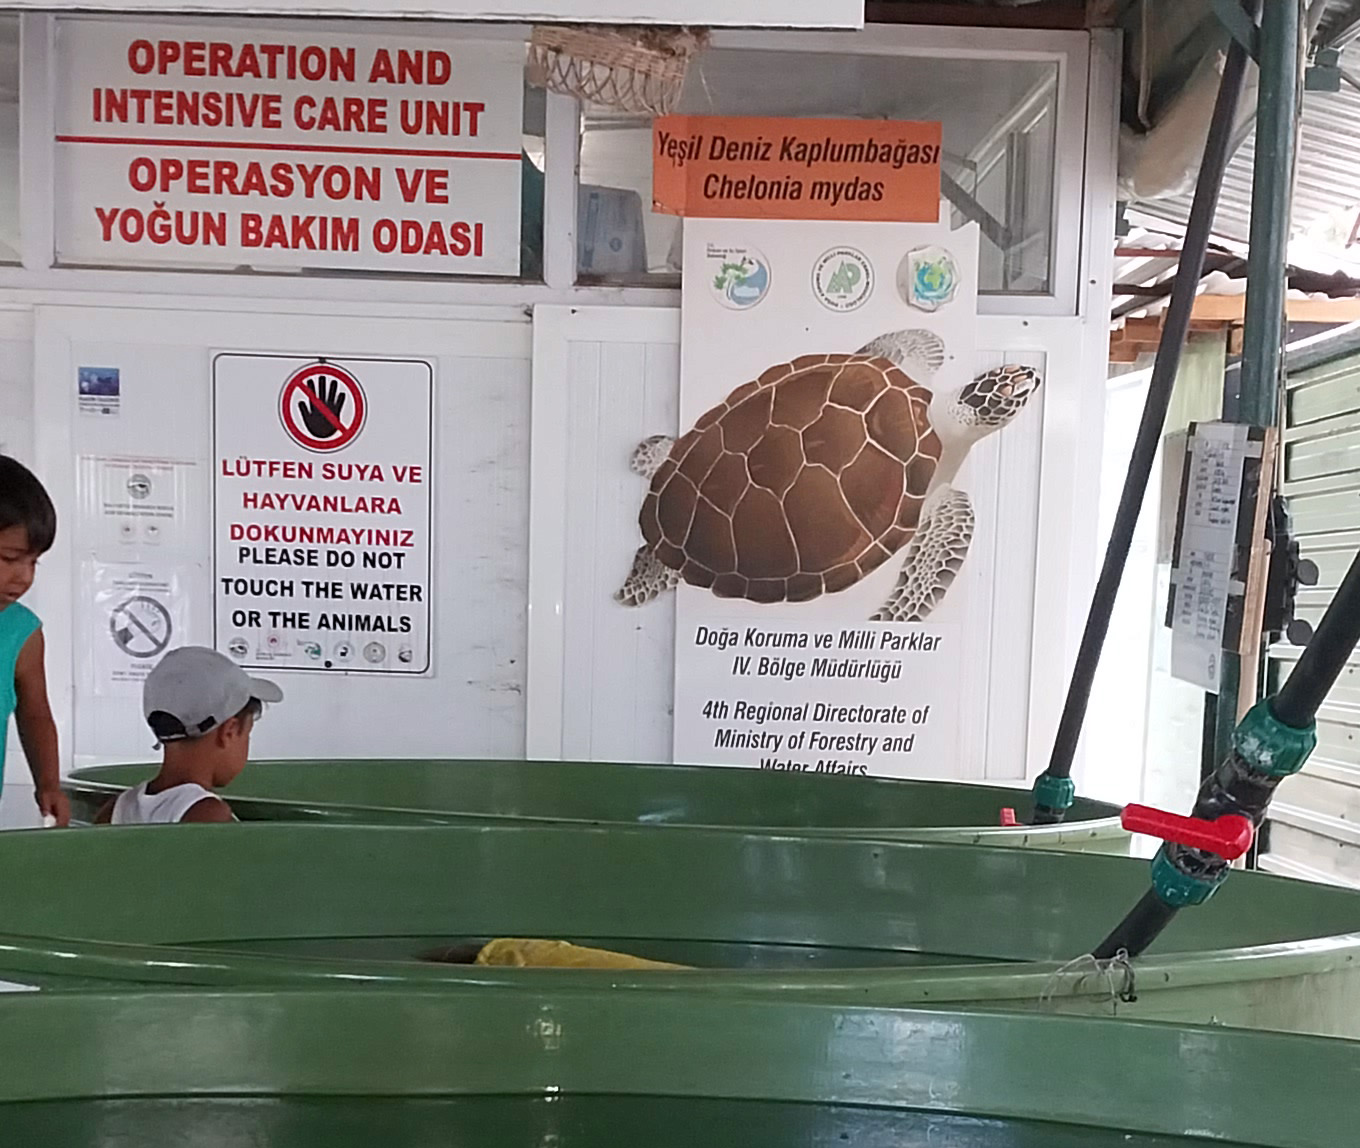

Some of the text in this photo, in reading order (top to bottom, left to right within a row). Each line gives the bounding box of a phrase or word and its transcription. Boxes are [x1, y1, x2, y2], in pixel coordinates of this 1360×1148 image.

[127, 39, 453, 86] OPERATION AND
[92, 87, 485, 138] INTENSIVE CARE UNIT
[656, 131, 940, 170] Yeşil Deniz Kaplumbağası
[128, 156, 450, 205] OPERASYON VE
[702, 173, 885, 206] Chelonia mydas
[94, 200, 484, 258] YOĞUN BAKIM ODASI
[222, 455, 423, 483] LÜTFEN SUYA VE
[242, 491, 402, 515] HAYVANLARA
[229, 523, 415, 548] DOKUNMAYINIZ
[238, 547, 406, 569] PLEASE DO NOT
[221, 578, 423, 602] TOUCH THE WATER
[231, 610, 412, 633] OR THE ANIMALS
[694, 626, 942, 652] Doğa Koruma ve Milli Parklar
[731, 656, 902, 683] IV. Bölge Müdürlüğü
[702, 701, 931, 726] 4th Regional Directorate of
[714, 729, 915, 754] Ministry of Forestry and
